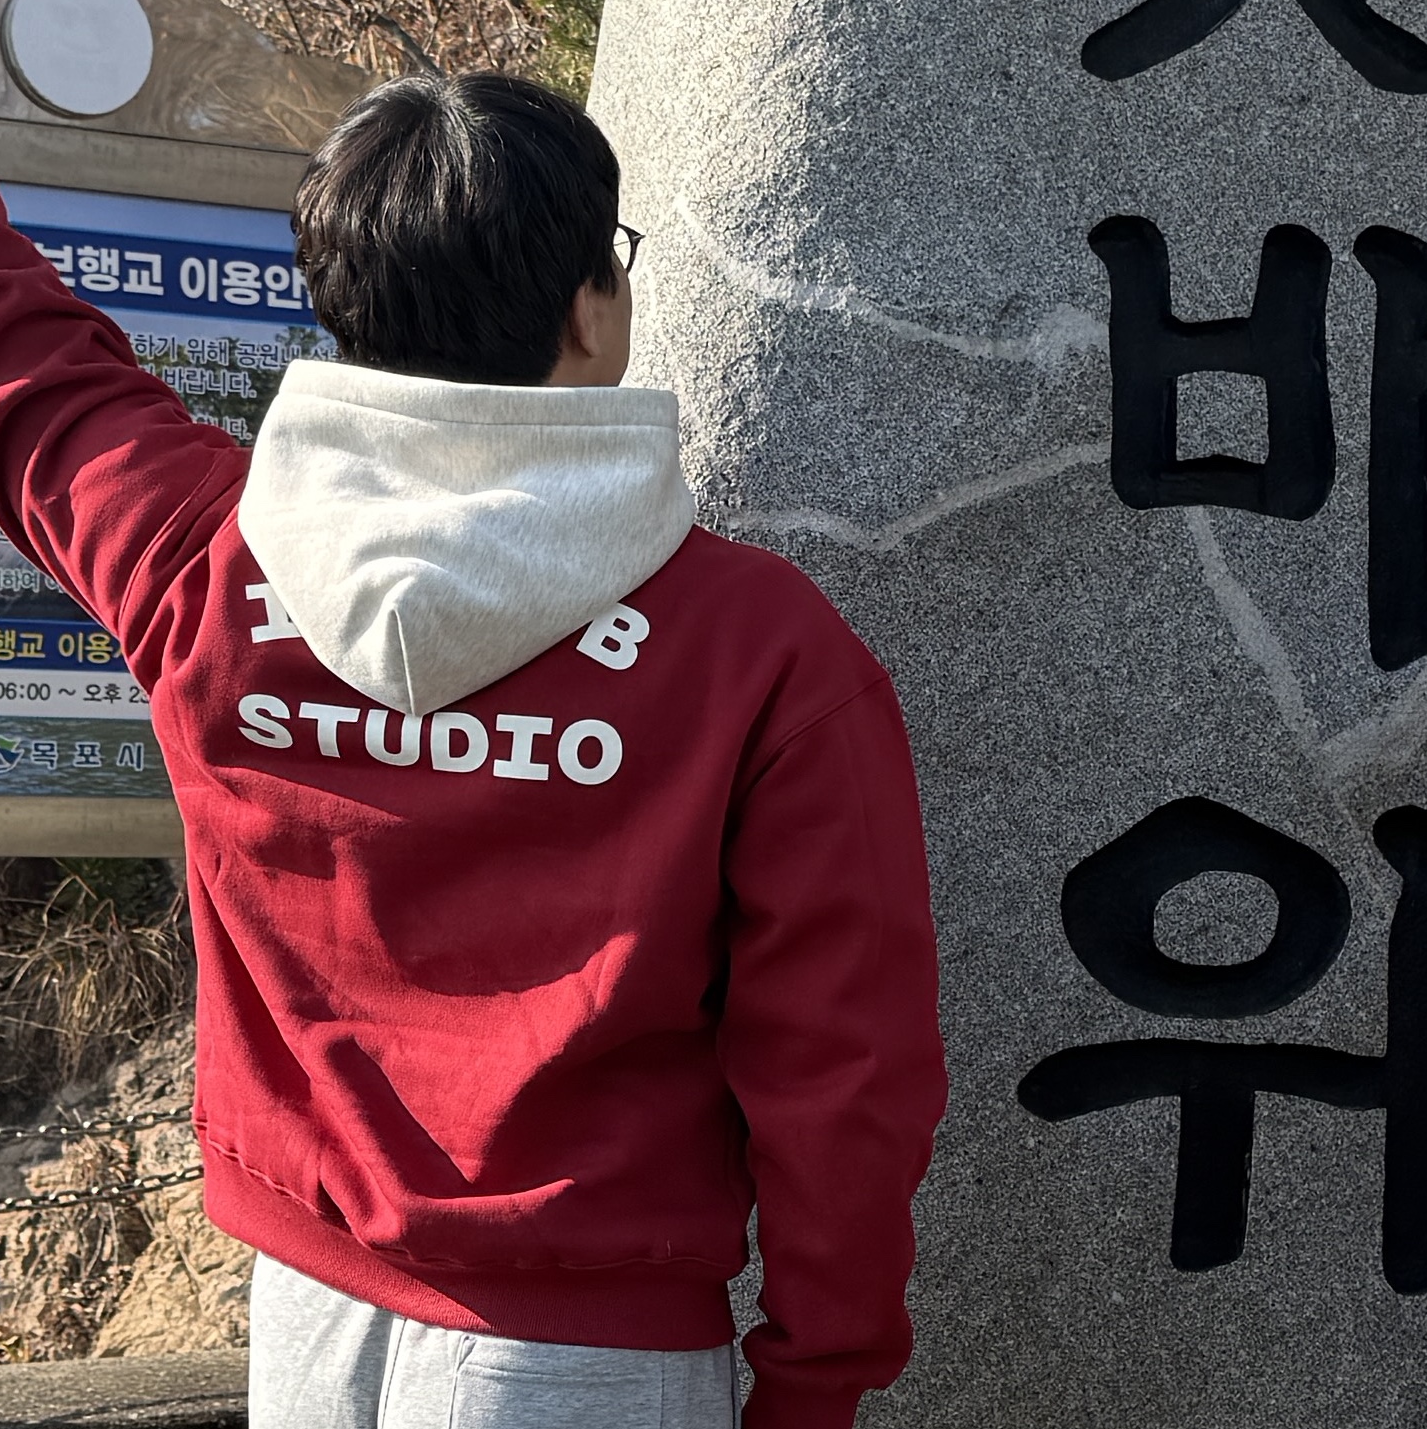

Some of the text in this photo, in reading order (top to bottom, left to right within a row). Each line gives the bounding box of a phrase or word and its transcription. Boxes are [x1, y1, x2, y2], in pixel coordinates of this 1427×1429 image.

[179, 256, 314, 310] 이용안
[121, 332, 177, 360] 하기
[187, 338, 228, 366] 위해
[163, 370, 257, 398] 바랍니다.
[83, 683, 121, 704] 오후
[31, 740, 145, 771] 목포시
[237, 693, 624, 786] STUDIO
